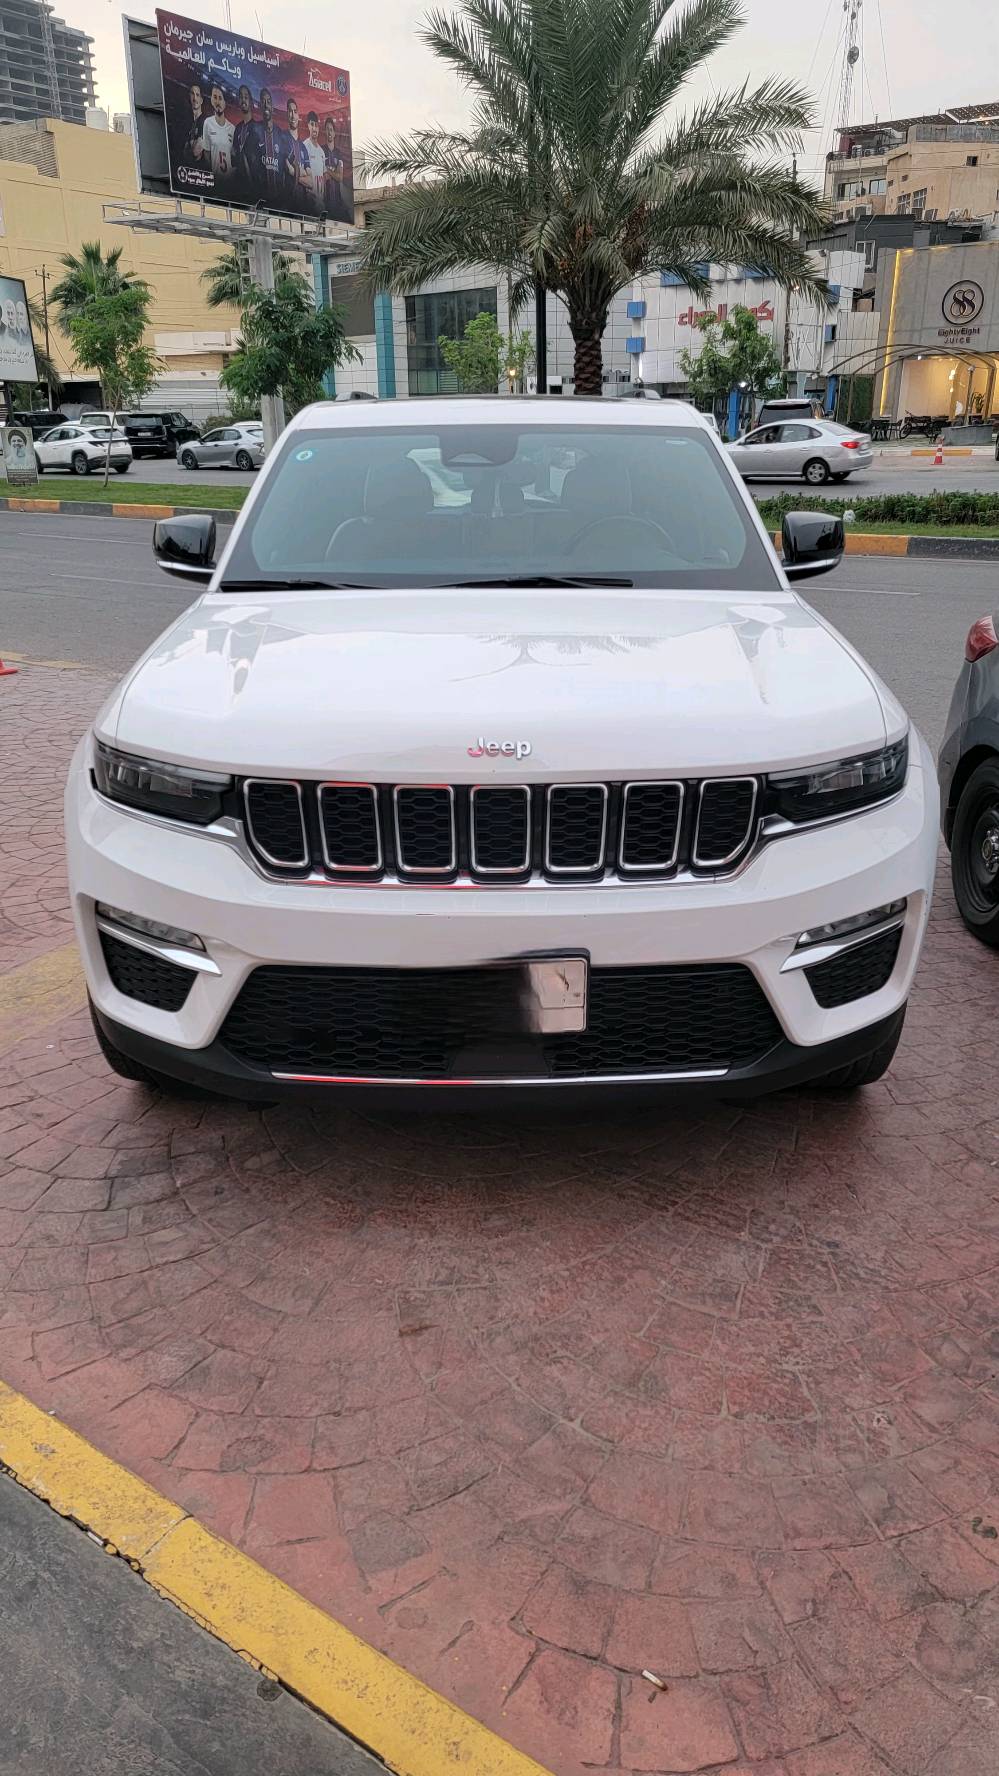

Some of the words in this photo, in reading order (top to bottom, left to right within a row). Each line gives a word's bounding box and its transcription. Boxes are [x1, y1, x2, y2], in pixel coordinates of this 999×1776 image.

[163, 20, 194, 43] جيرمان
[196, 31, 213, 47] سان
[216, 41, 245, 60] وباريس
[466, 737, 532, 760] Jeep
